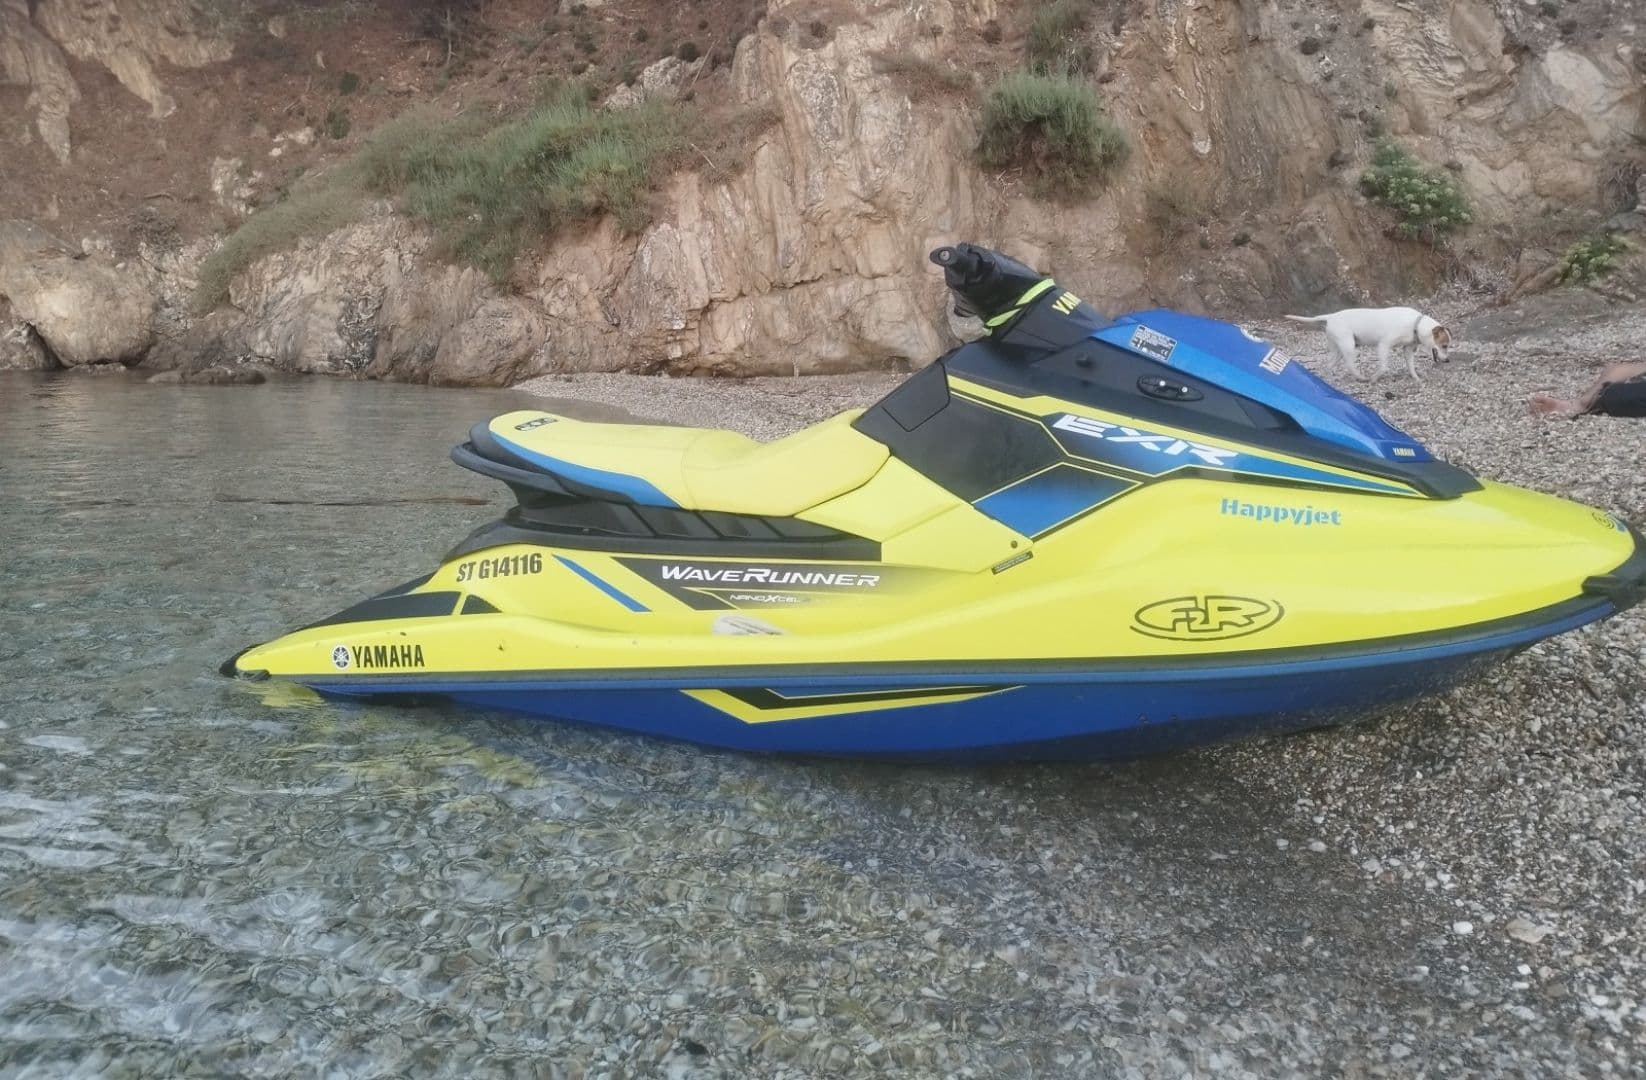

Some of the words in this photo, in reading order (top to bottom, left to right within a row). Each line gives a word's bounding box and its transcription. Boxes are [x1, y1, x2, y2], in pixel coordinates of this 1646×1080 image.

[1052, 414, 1239, 466] EXR
[1220, 498, 1342, 526] Happyjet
[456, 561, 477, 582] ST
[478, 552, 543, 579] G14116
[351, 644, 425, 669] YAMAHA
